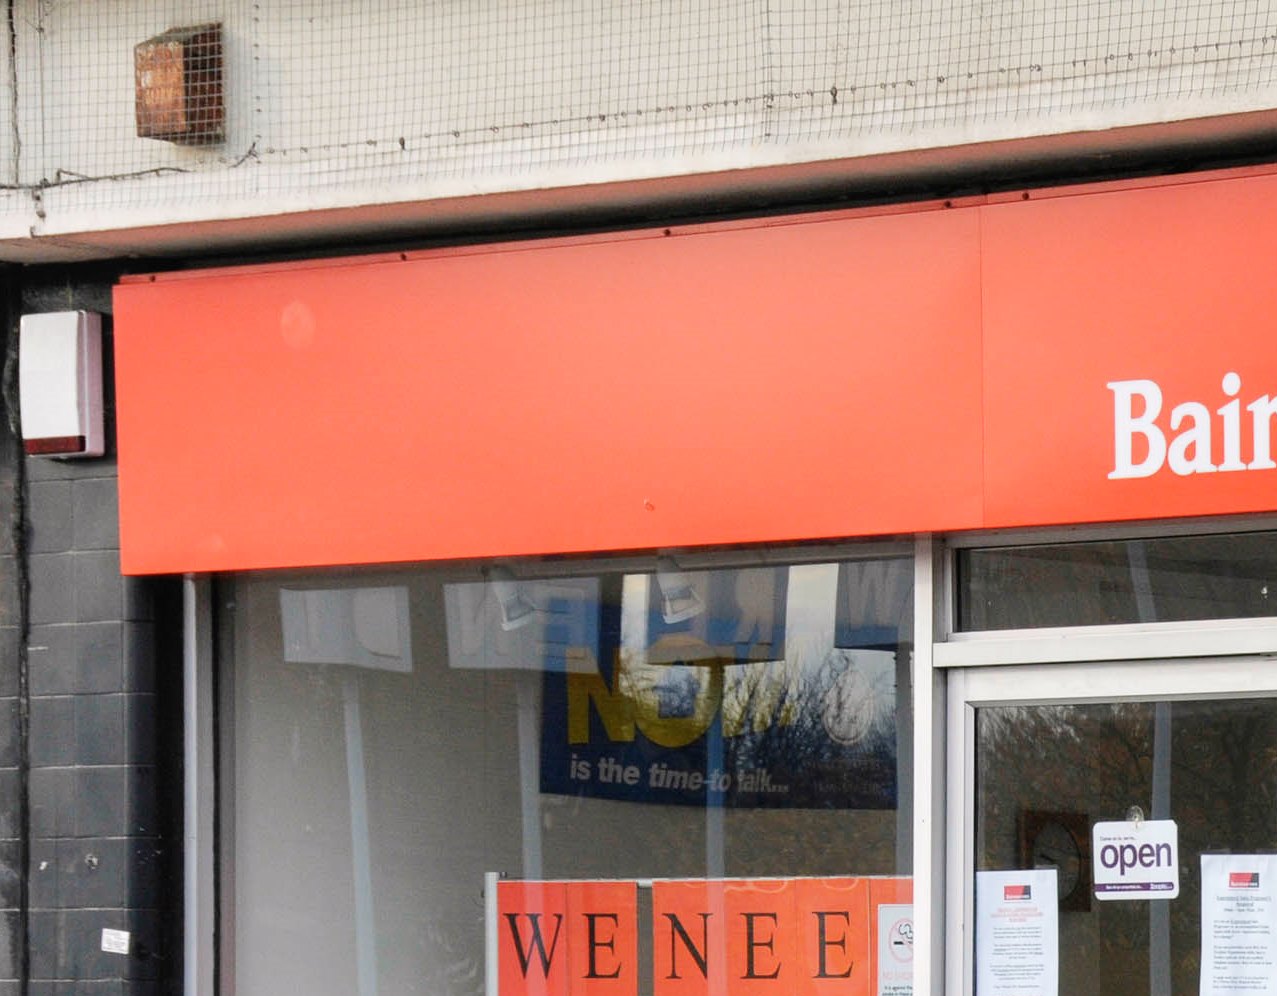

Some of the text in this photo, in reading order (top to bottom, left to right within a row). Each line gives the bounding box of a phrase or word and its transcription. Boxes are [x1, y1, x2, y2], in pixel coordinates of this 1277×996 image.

[570, 754, 591, 782] is
[597, 758, 640, 785] the
[649, 762, 710, 791] time
[710, 767, 731, 793] to
[1100, 843, 1172, 876] open
[504, 912, 622, 980] WE
